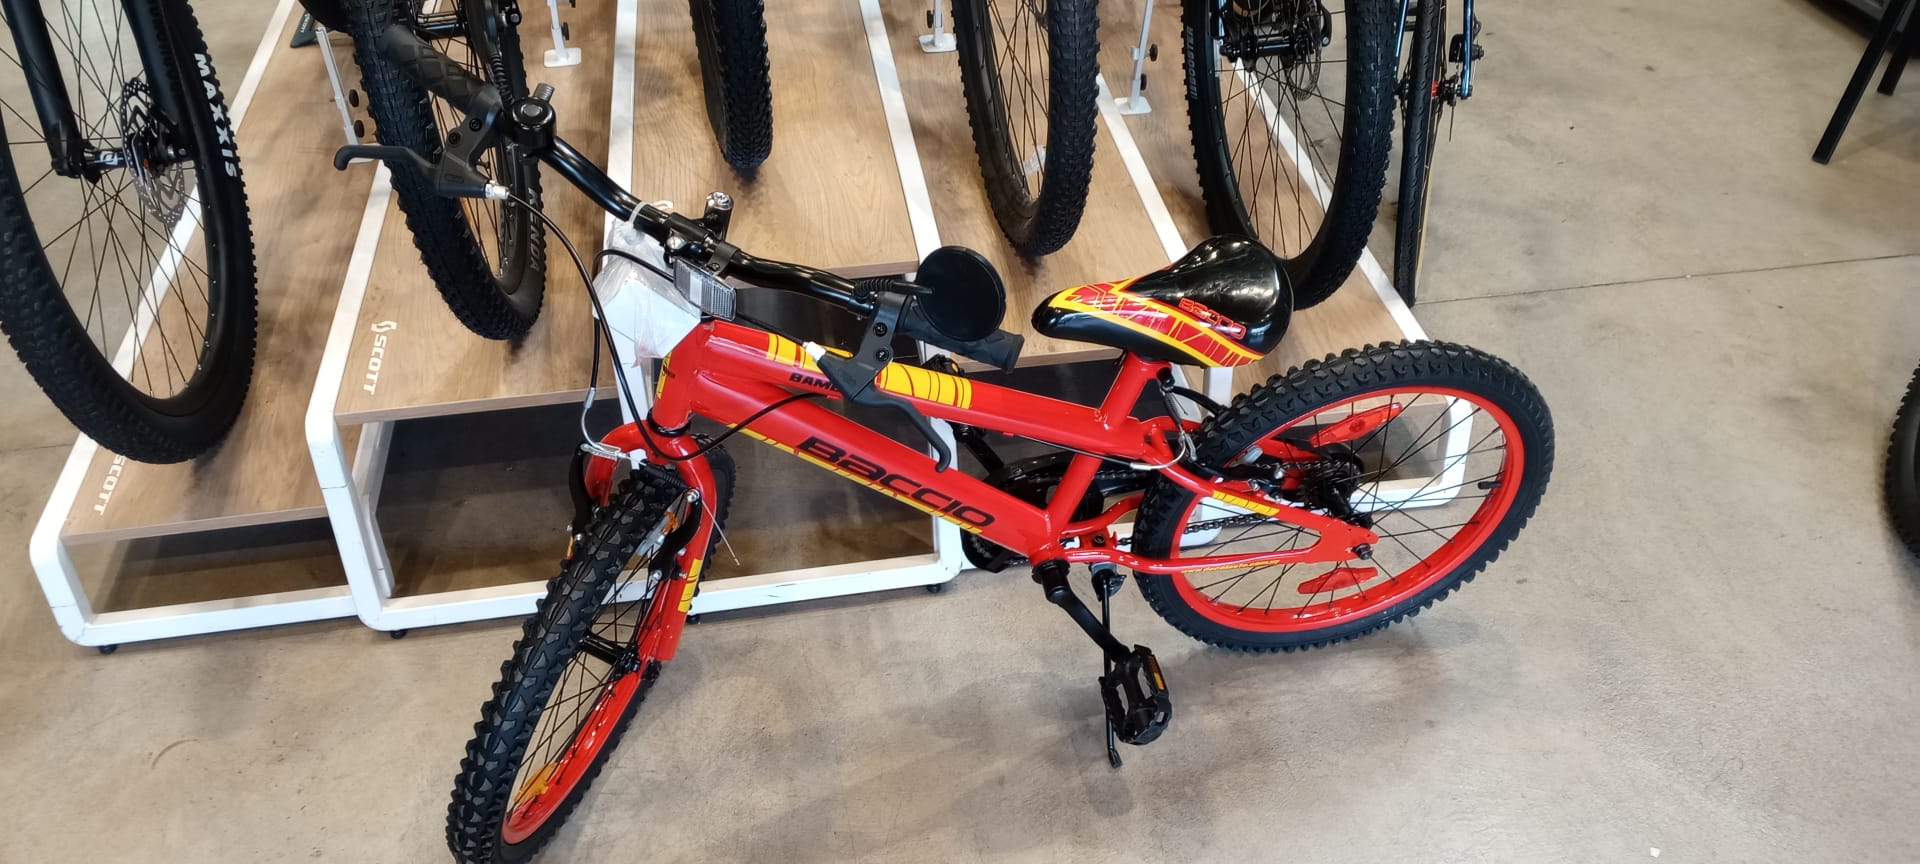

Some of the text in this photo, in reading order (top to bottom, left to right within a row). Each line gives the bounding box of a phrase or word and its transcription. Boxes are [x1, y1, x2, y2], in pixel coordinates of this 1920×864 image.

[194, 53, 237, 177] MAXXIS
[528, 187, 540, 272] KENDA
[363, 333, 387, 396] SCOTT
[94, 454, 126, 516] SCOTT
